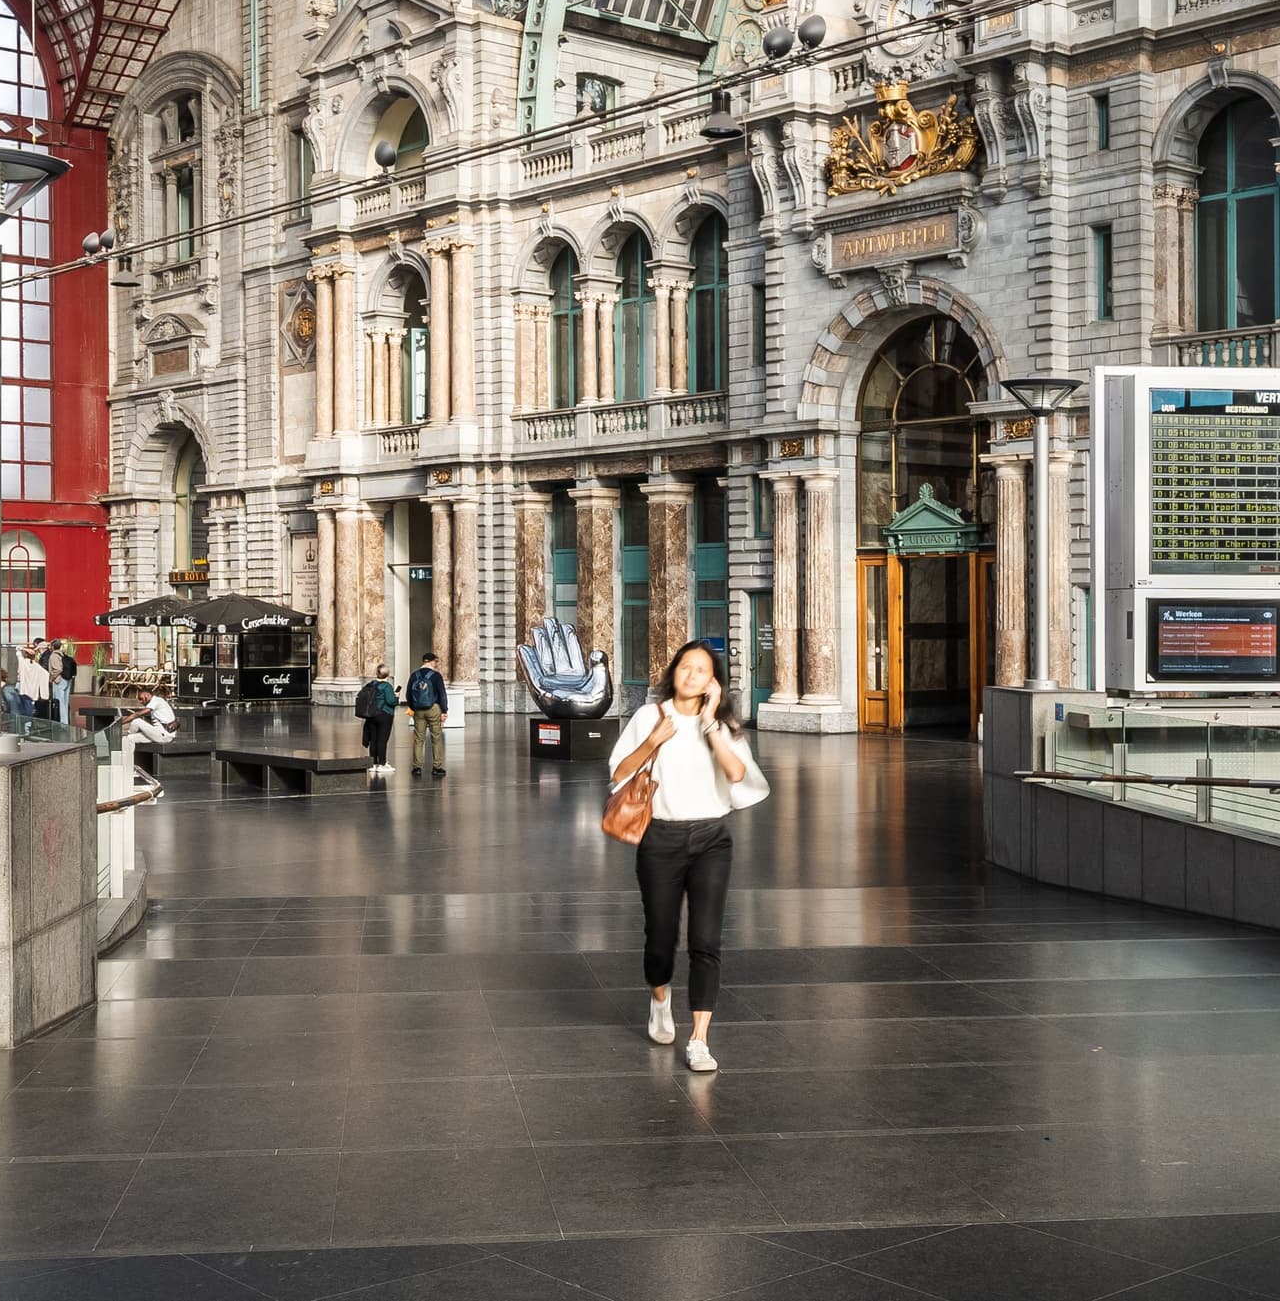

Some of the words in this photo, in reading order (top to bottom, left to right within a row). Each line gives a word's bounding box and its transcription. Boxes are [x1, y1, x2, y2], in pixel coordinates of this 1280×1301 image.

[842, 224, 945, 256] ANTWERPEN
[1161, 404, 1176, 413] UUR
[1225, 405, 1269, 414] BESTEMMING
[1184, 465, 1204, 473] Lier
[1184, 490, 1204, 499] Lier
[1184, 527, 1204, 536] Lier
[909, 534, 952, 545] UITGANG
[1175, 610, 1203, 618] Werken
